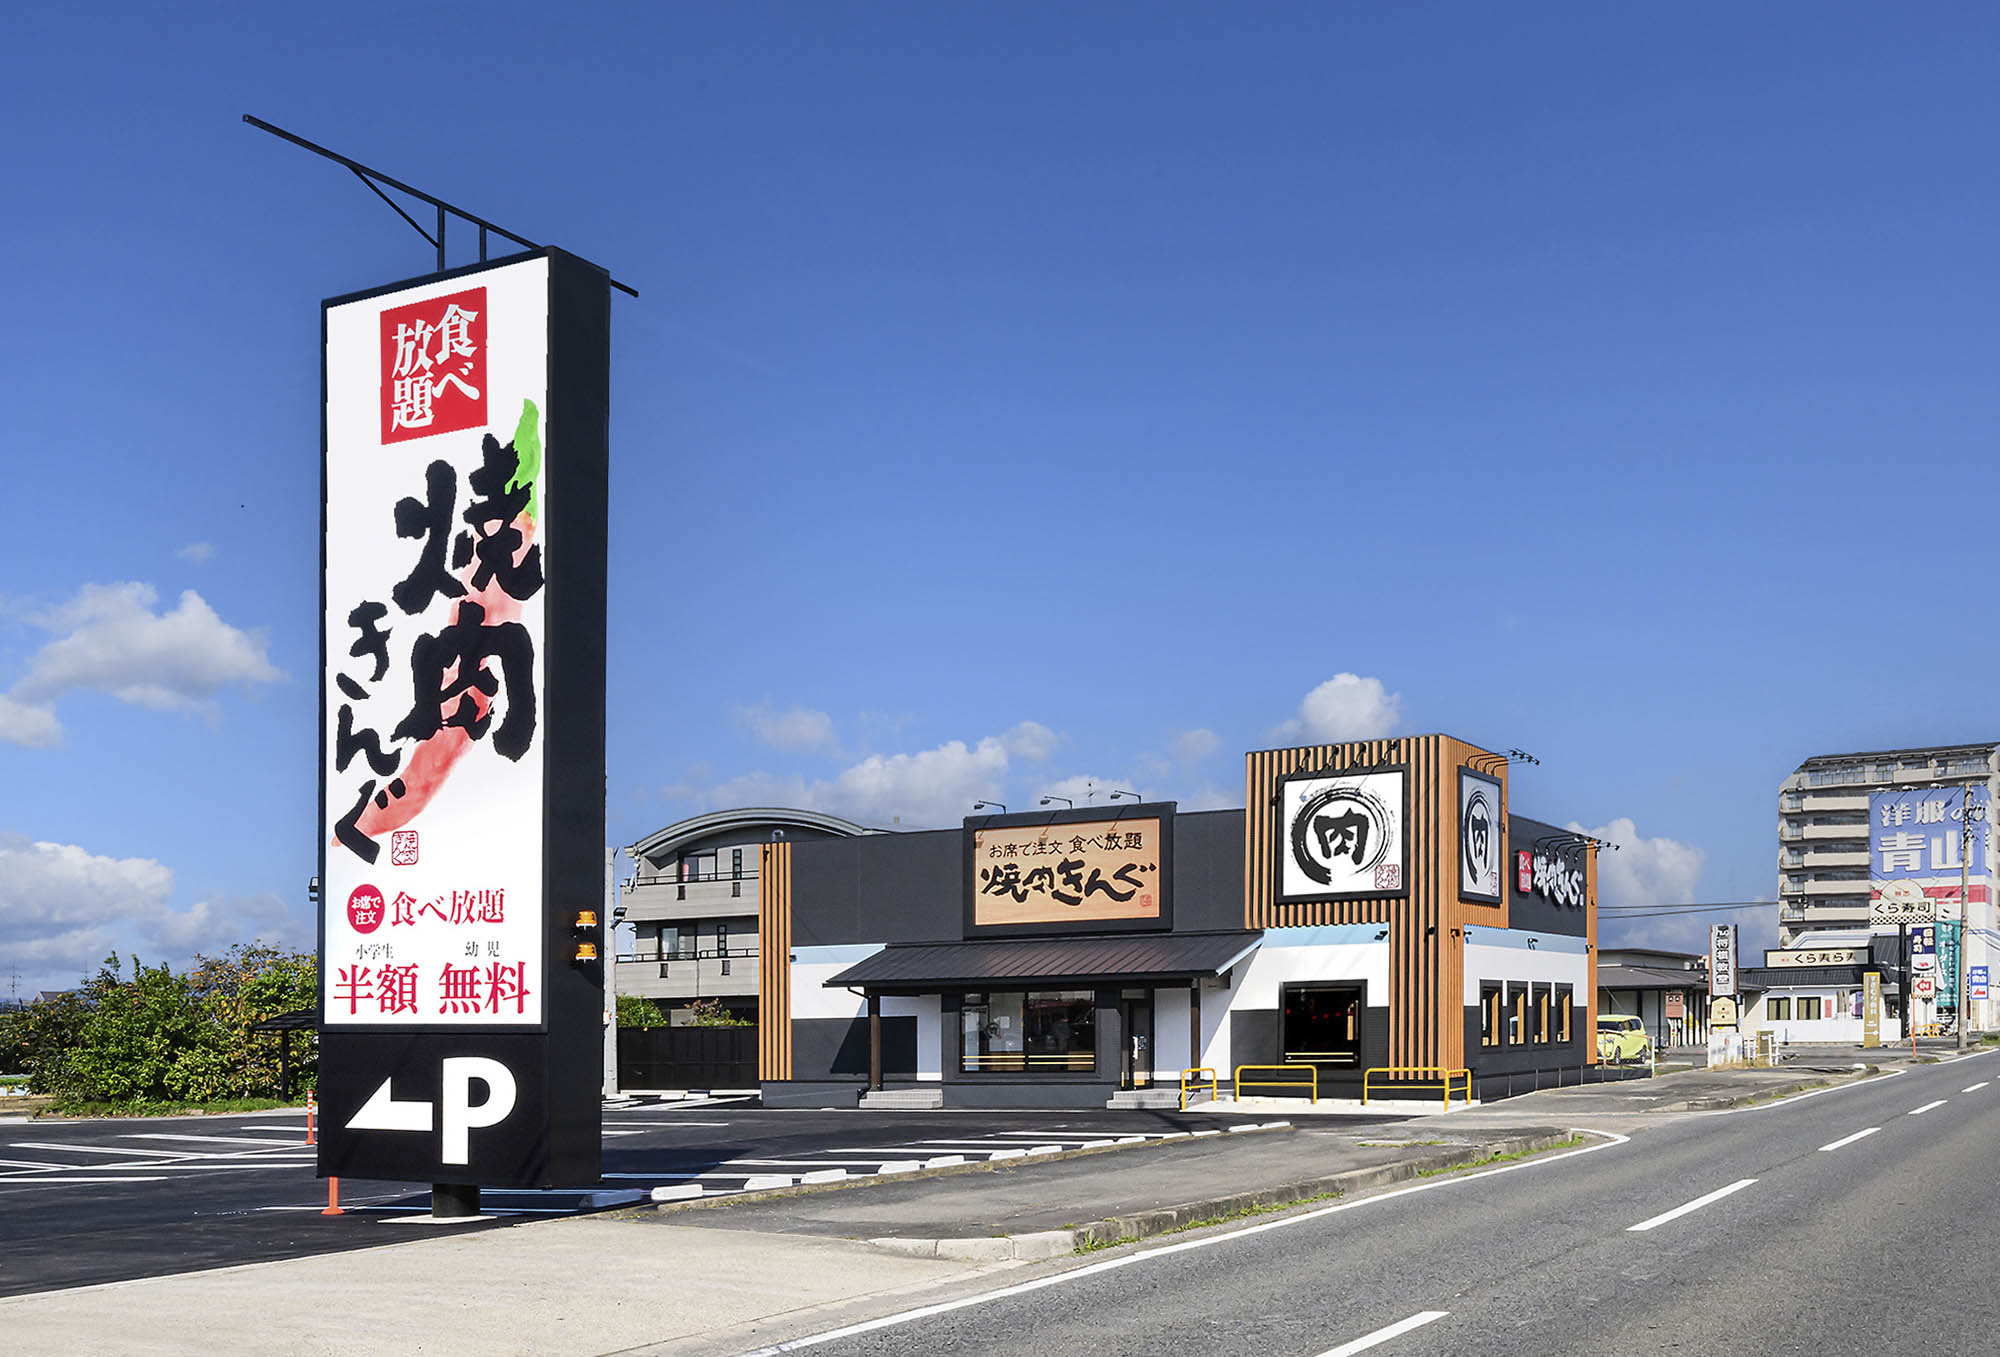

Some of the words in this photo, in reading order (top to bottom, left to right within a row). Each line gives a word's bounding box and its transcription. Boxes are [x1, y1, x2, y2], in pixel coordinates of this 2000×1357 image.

[1068, 831, 1144, 855] 食べ放題
[1878, 830, 1974, 873] 青山
[980, 857, 1157, 907] 焼肉きんぐ
[355, 910, 377, 925] 注文
[391, 887, 505, 927] 食べ放題
[332, 962, 420, 1016] 半額
[438, 961, 531, 1015] 無料
[441, 1056, 518, 1166] P
